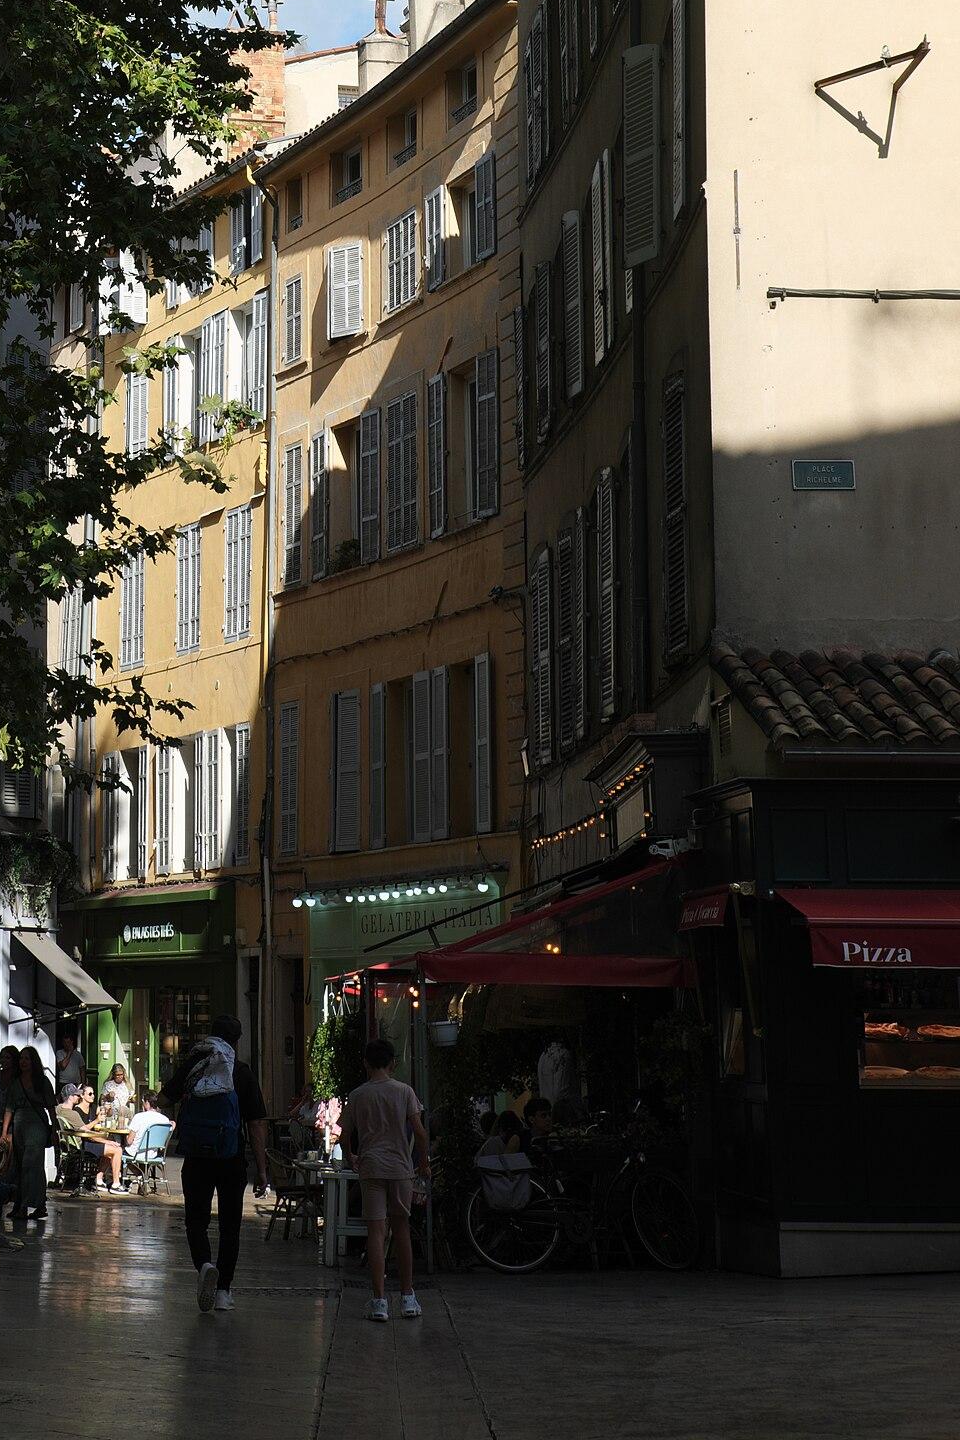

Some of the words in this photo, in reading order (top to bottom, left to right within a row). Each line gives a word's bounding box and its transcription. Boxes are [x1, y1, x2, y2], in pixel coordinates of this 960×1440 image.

[812, 465, 836, 473] PLACE
[806, 476, 842, 484] RICHELME
[360, 910, 438, 935] GELATERIA
[443, 905, 494, 929] ITALIA
[842, 940, 913, 963] Pizza
